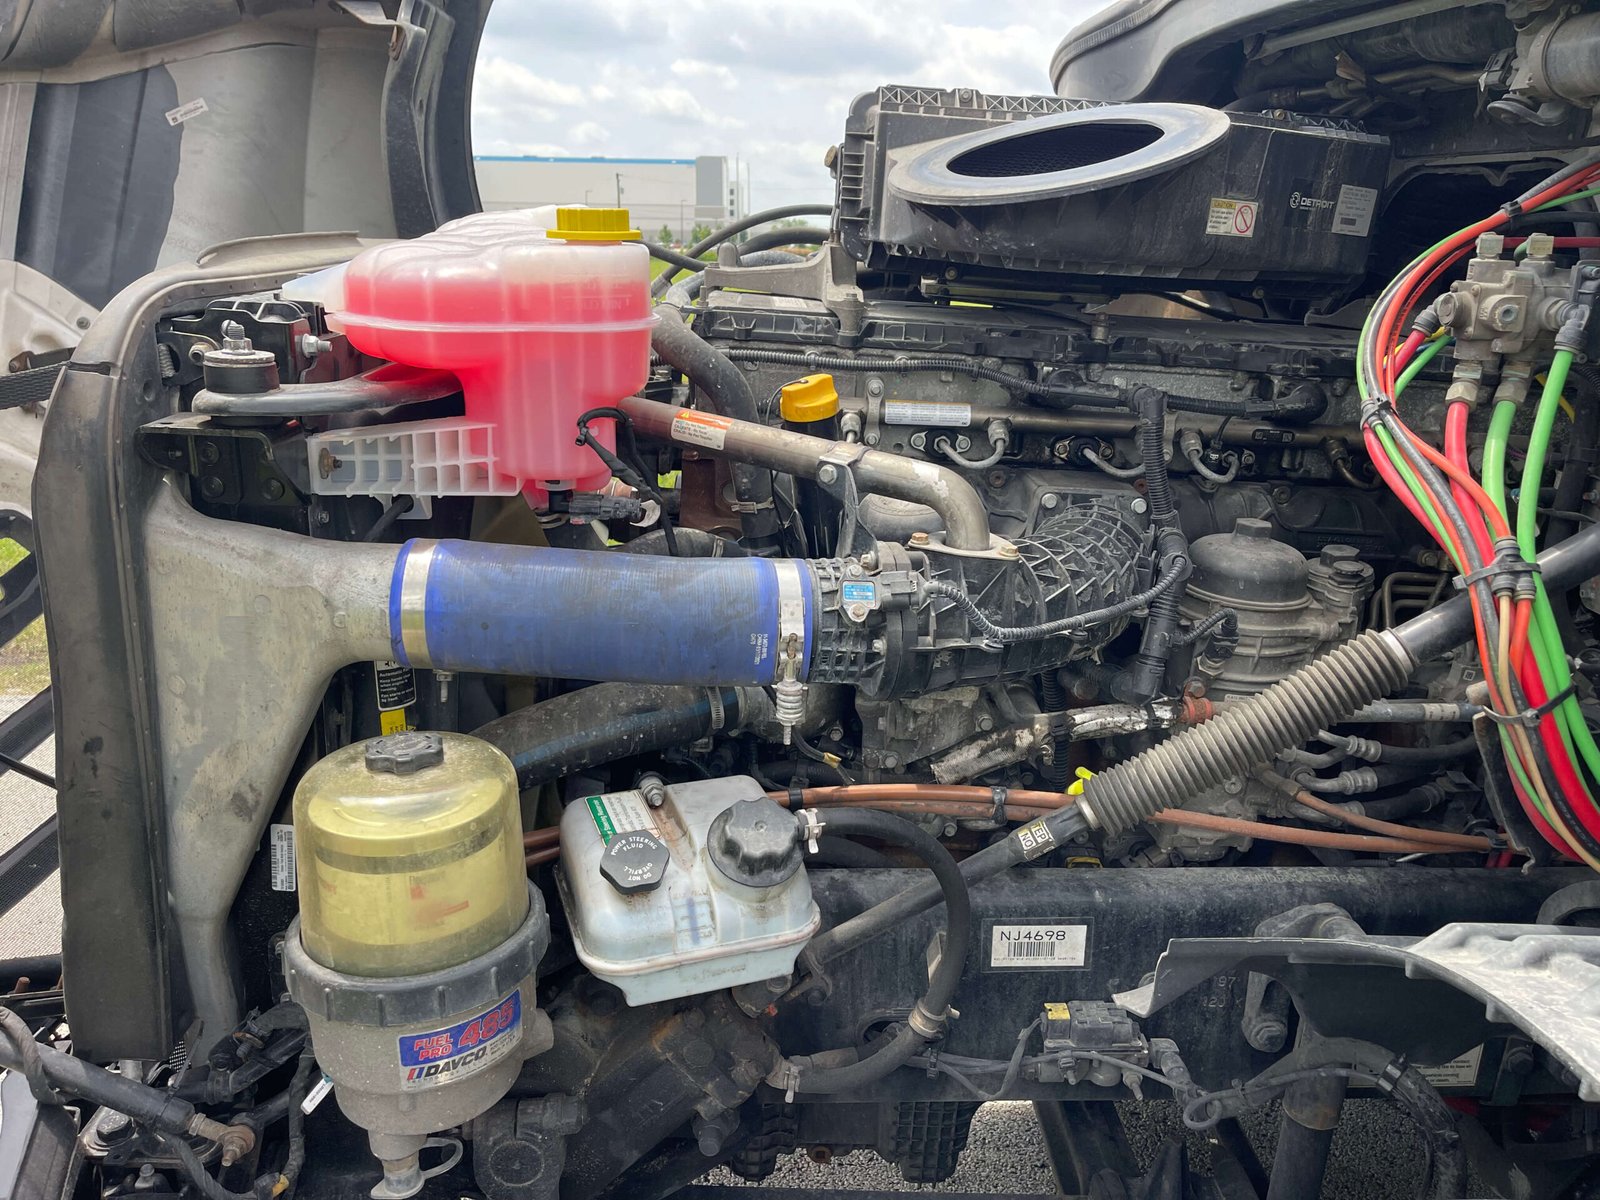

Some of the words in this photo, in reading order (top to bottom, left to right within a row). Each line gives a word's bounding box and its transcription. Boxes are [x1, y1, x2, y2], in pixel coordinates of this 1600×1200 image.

[1300, 197, 1335, 209] DETROIT
[610, 839, 627, 856] POWER
[628, 836, 658, 850] STEERING
[622, 843, 644, 852] FLUID
[623, 862, 653, 875] OVERFILL
[642, 871, 652, 880] DO
[1000, 930, 1067, 941] NJ4698
[458, 999, 515, 1048] 485
[413, 1033, 454, 1052] FUEL
[418, 1044, 453, 1062] PRO
[424, 1045, 486, 1078] DAVCO
